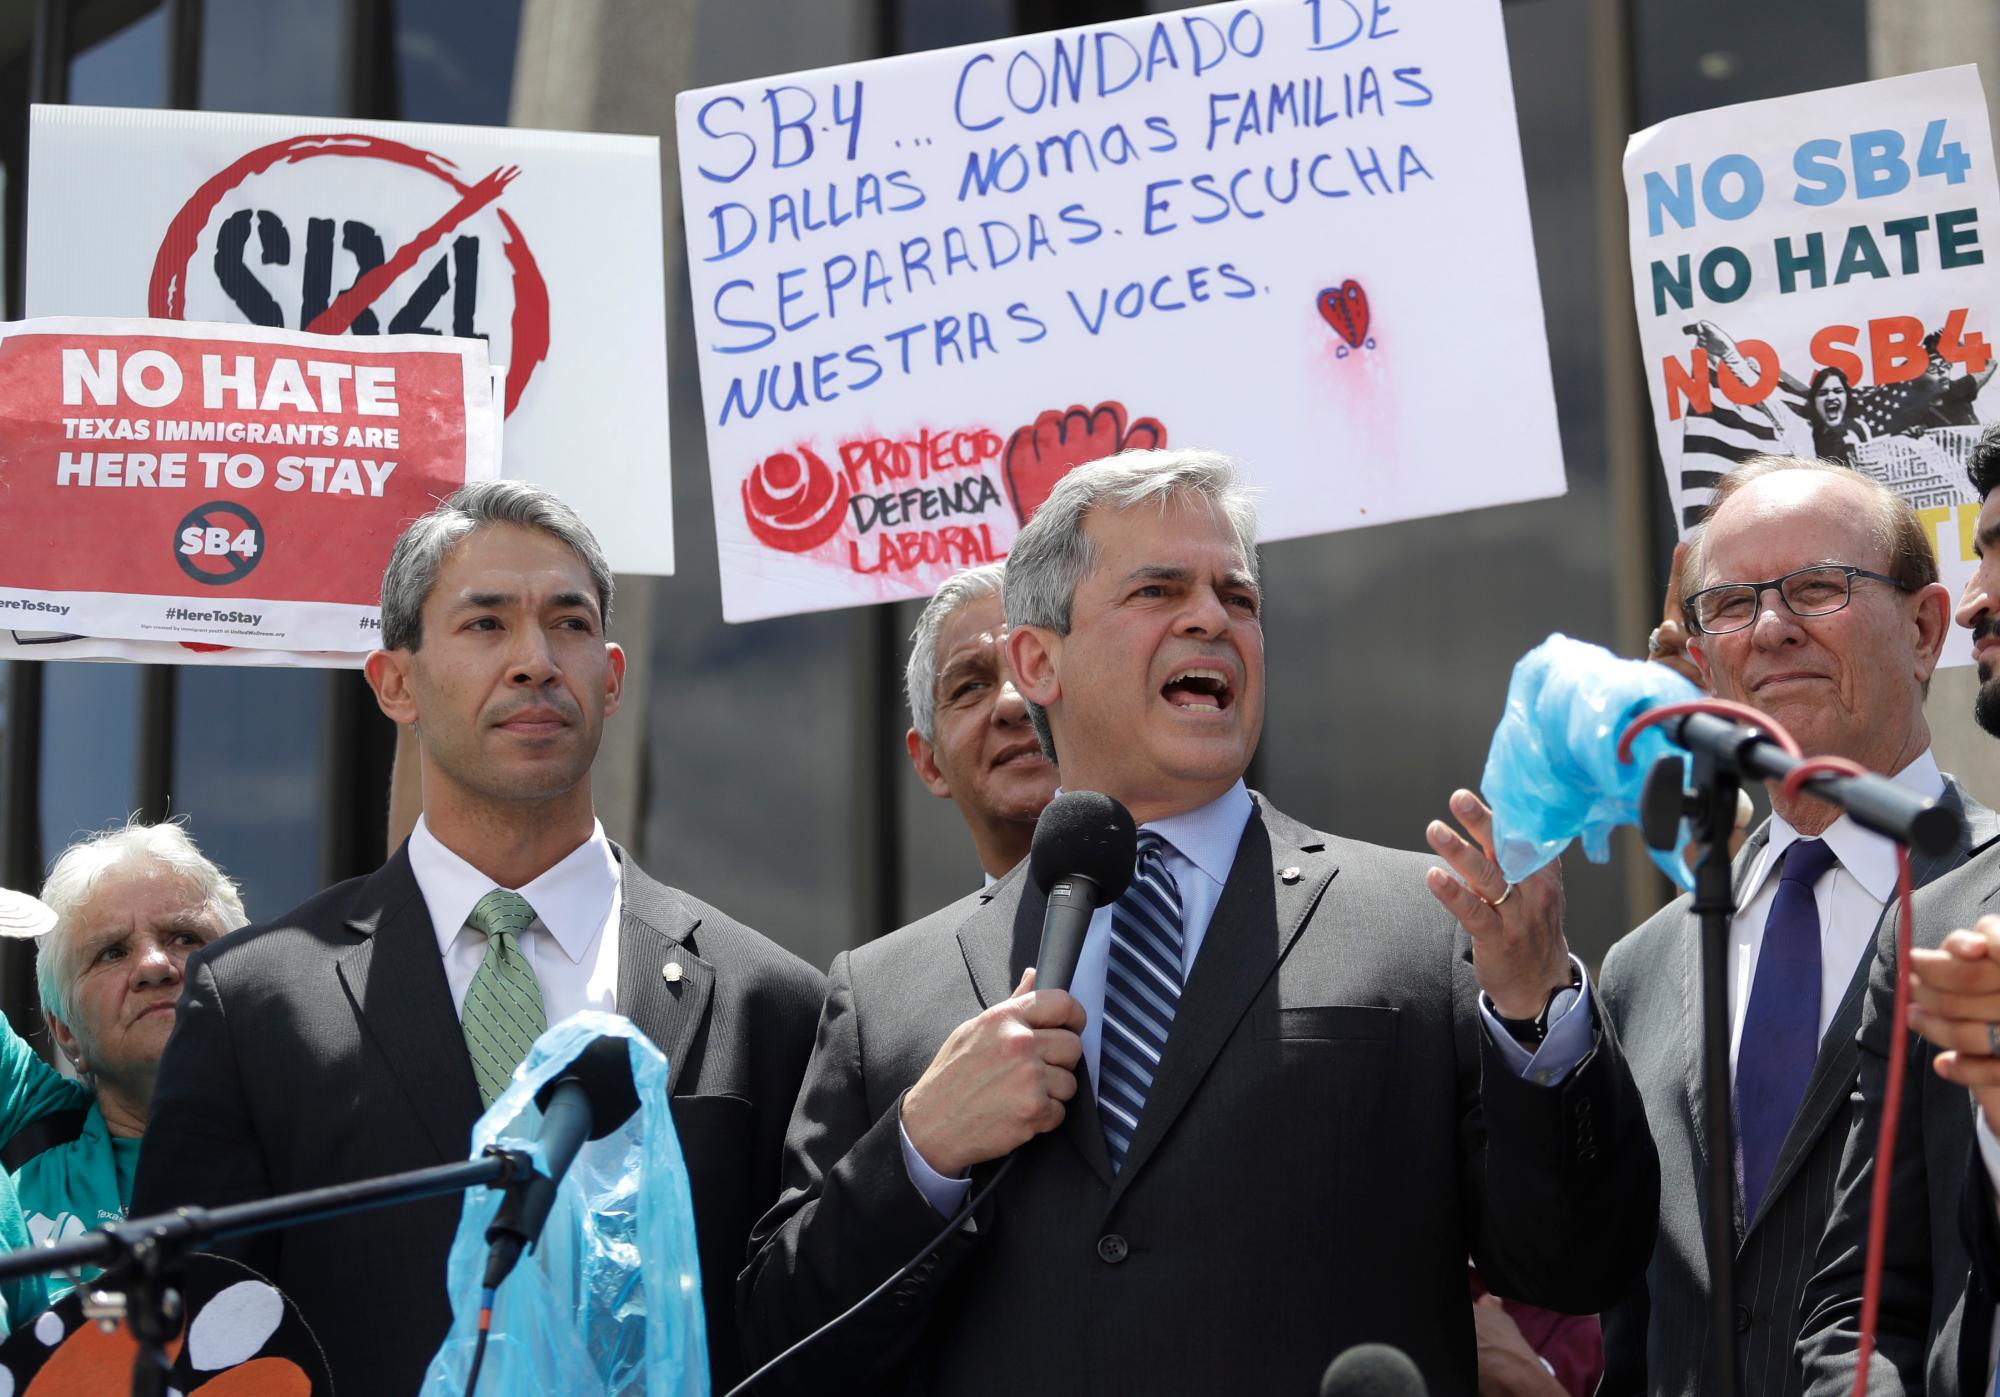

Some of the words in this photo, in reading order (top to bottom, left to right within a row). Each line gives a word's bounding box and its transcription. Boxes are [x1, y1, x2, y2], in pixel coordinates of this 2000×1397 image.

[954, 9, 1264, 131] CONDADO
[1304, 0, 1399, 51] DE
[703, 171, 926, 262] DALLAS
[1207, 66, 1433, 150] FAMILIAS
[1643, 153, 1764, 237] NO
[1792, 118, 1972, 206] SB4
[214, 209, 489, 340] SB4
[712, 204, 1122, 354] SEPARADAS.
[1144, 144, 1434, 236] ESCUCHA
[1650, 246, 1751, 316] NO
[1774, 207, 1984, 294] HATE
[62, 349, 184, 409] NO
[202, 354, 400, 417] HATE
[719, 303, 1047, 426] NUESTRAS
[1067, 263, 1269, 335] VOCES.
[1662, 338, 1780, 421] NO
[1809, 308, 1993, 388] SB4
[56, 452, 187, 487] HERE
[198, 453, 265, 488] TO
[274, 456, 398, 497] STAY
[62, 418, 150, 440] TEXAS
[155, 420, 339, 447] IMMIGRANTS
[343, 425, 400, 449] ARE
[179, 527, 257, 557] SB4
[848, 474, 1002, 534] DEFENSA
[849, 523, 1008, 574] LABORAL
[166, 608, 262, 626] #HereToStay
